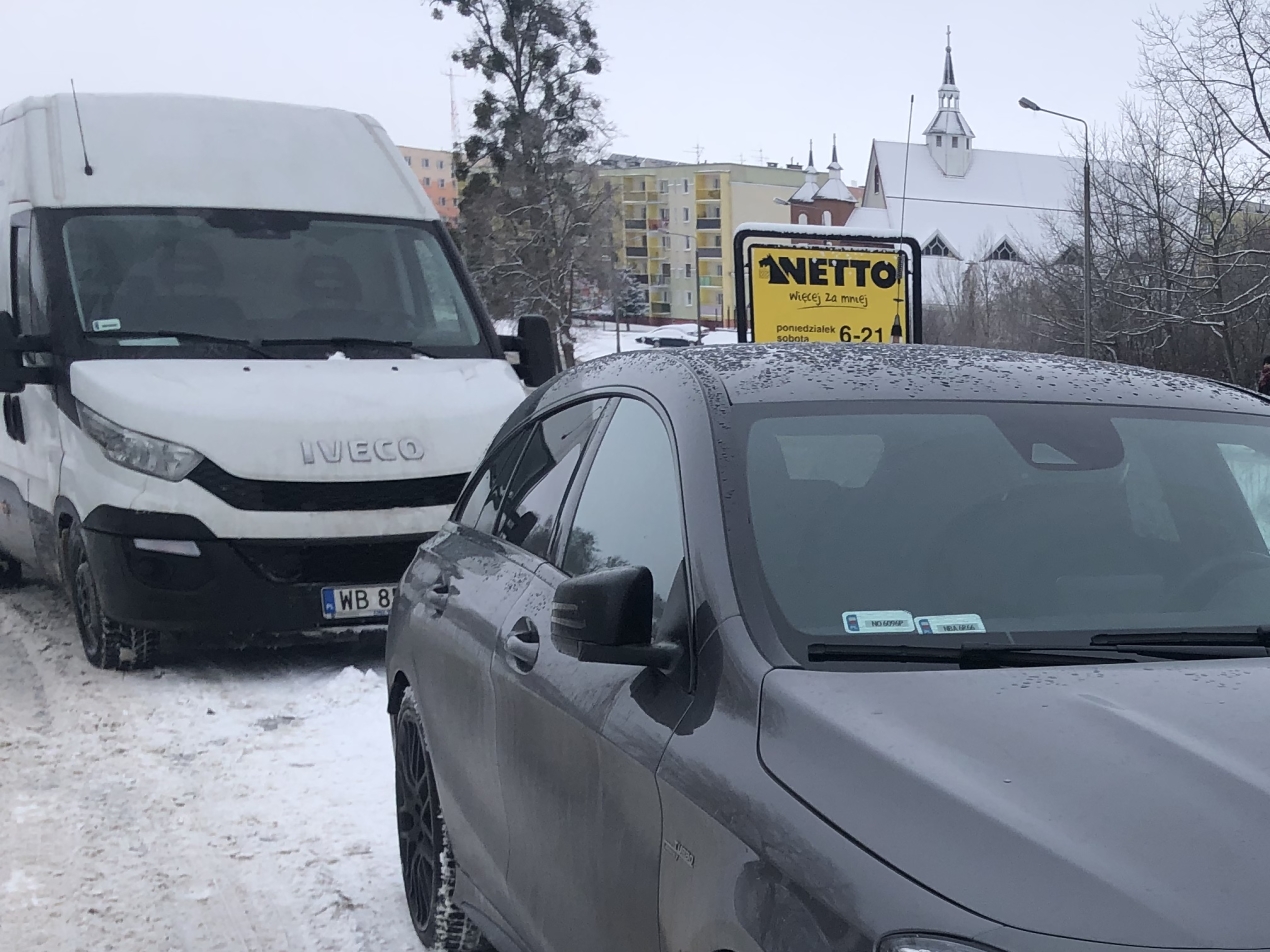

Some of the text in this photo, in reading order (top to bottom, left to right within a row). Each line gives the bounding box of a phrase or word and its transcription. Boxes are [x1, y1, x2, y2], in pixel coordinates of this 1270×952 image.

[778, 256, 896, 288] NETTO
[789, 290, 821, 306] Więcej
[841, 294, 868, 308] mniej
[776, 324, 835, 334] poniedziałek
[776, 334, 809, 342] sobota
[839, 325, 883, 343] 6-21
[301, 438, 425, 465] IVECO
[340, 590, 369, 610] WB
